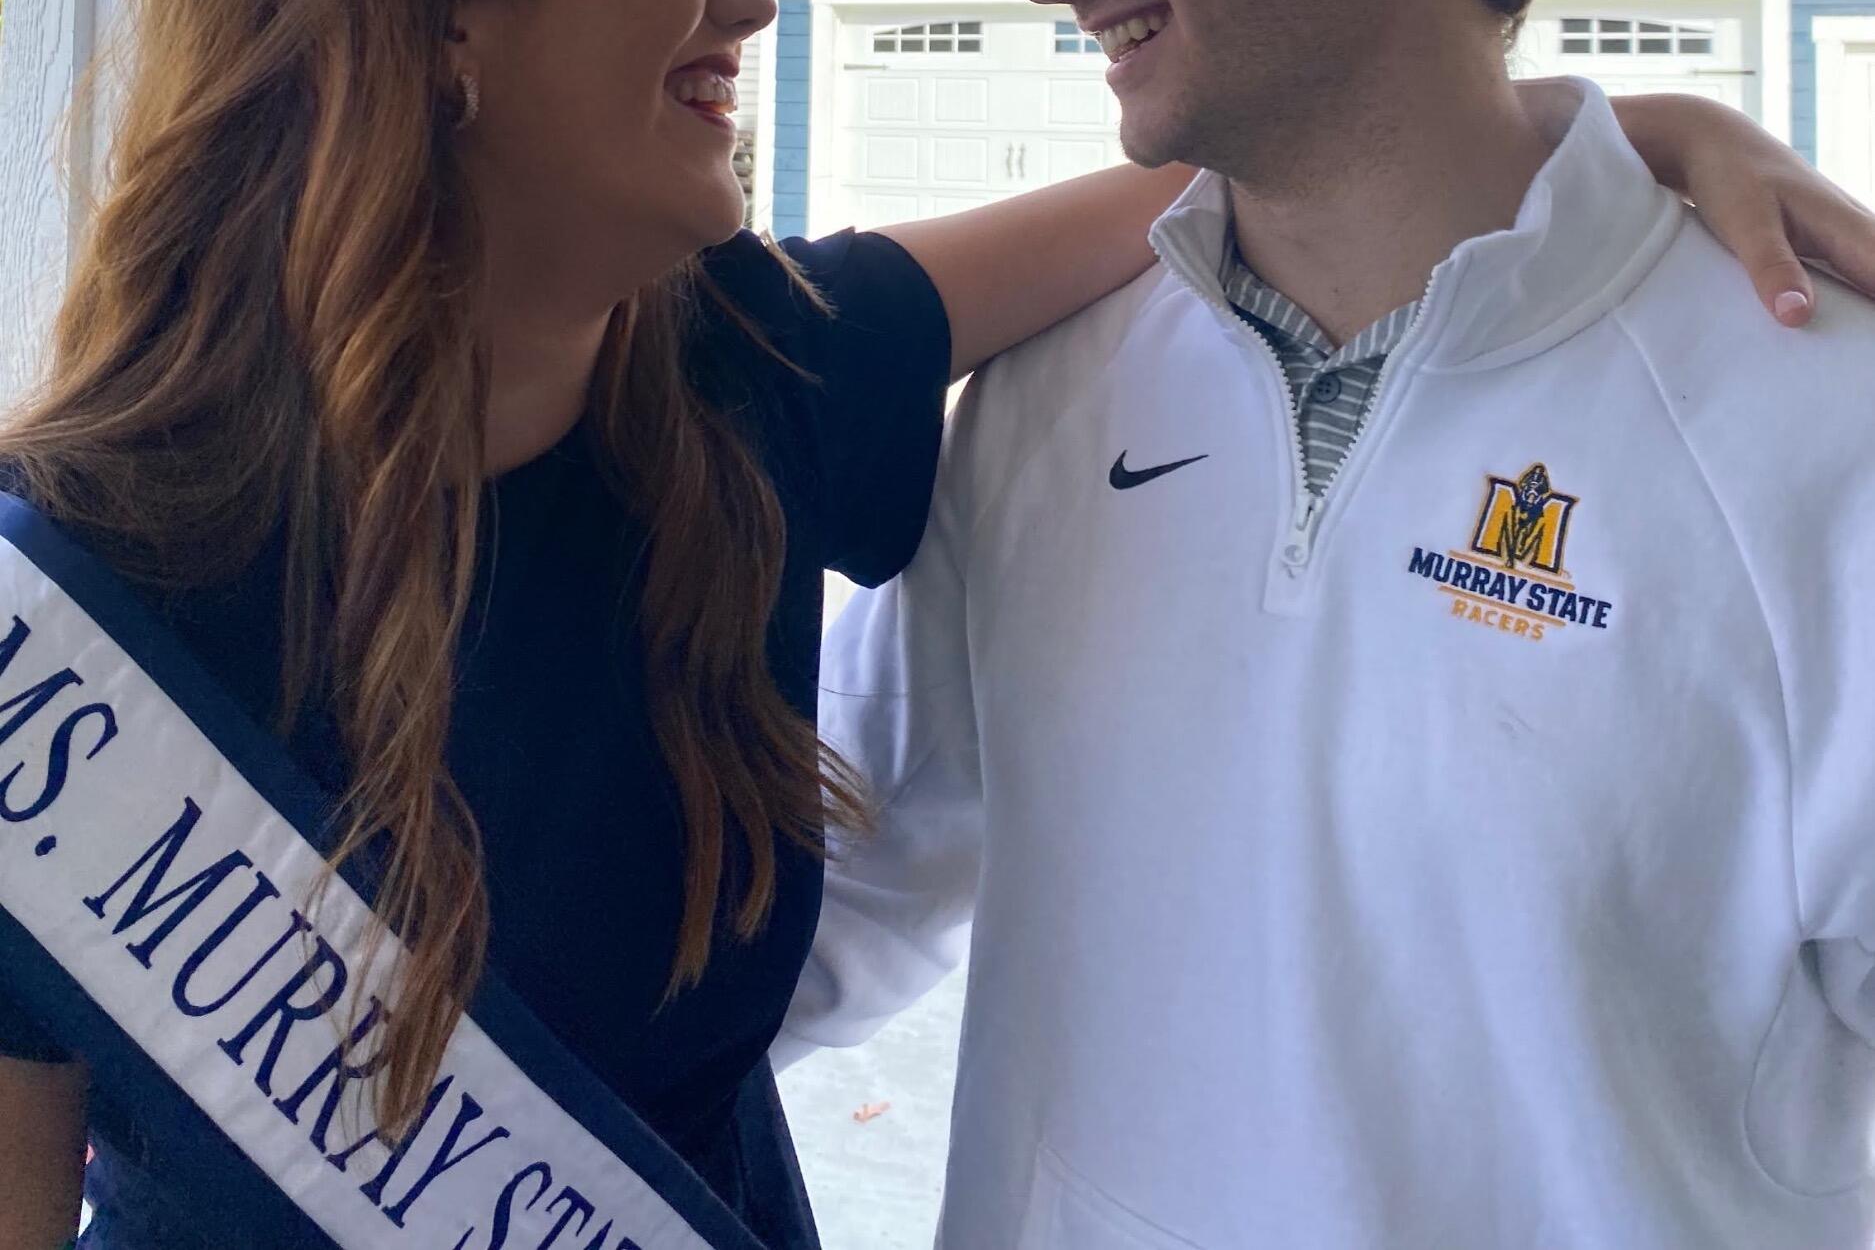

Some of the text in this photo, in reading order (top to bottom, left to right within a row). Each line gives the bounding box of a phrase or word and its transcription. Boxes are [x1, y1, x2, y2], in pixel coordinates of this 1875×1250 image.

[1408, 547, 1612, 629] MURRAY STATE
[1451, 599, 1545, 642] RACERS
[82, 796, 510, 1228] MURRAY
[452, 1161, 643, 1250] ST
